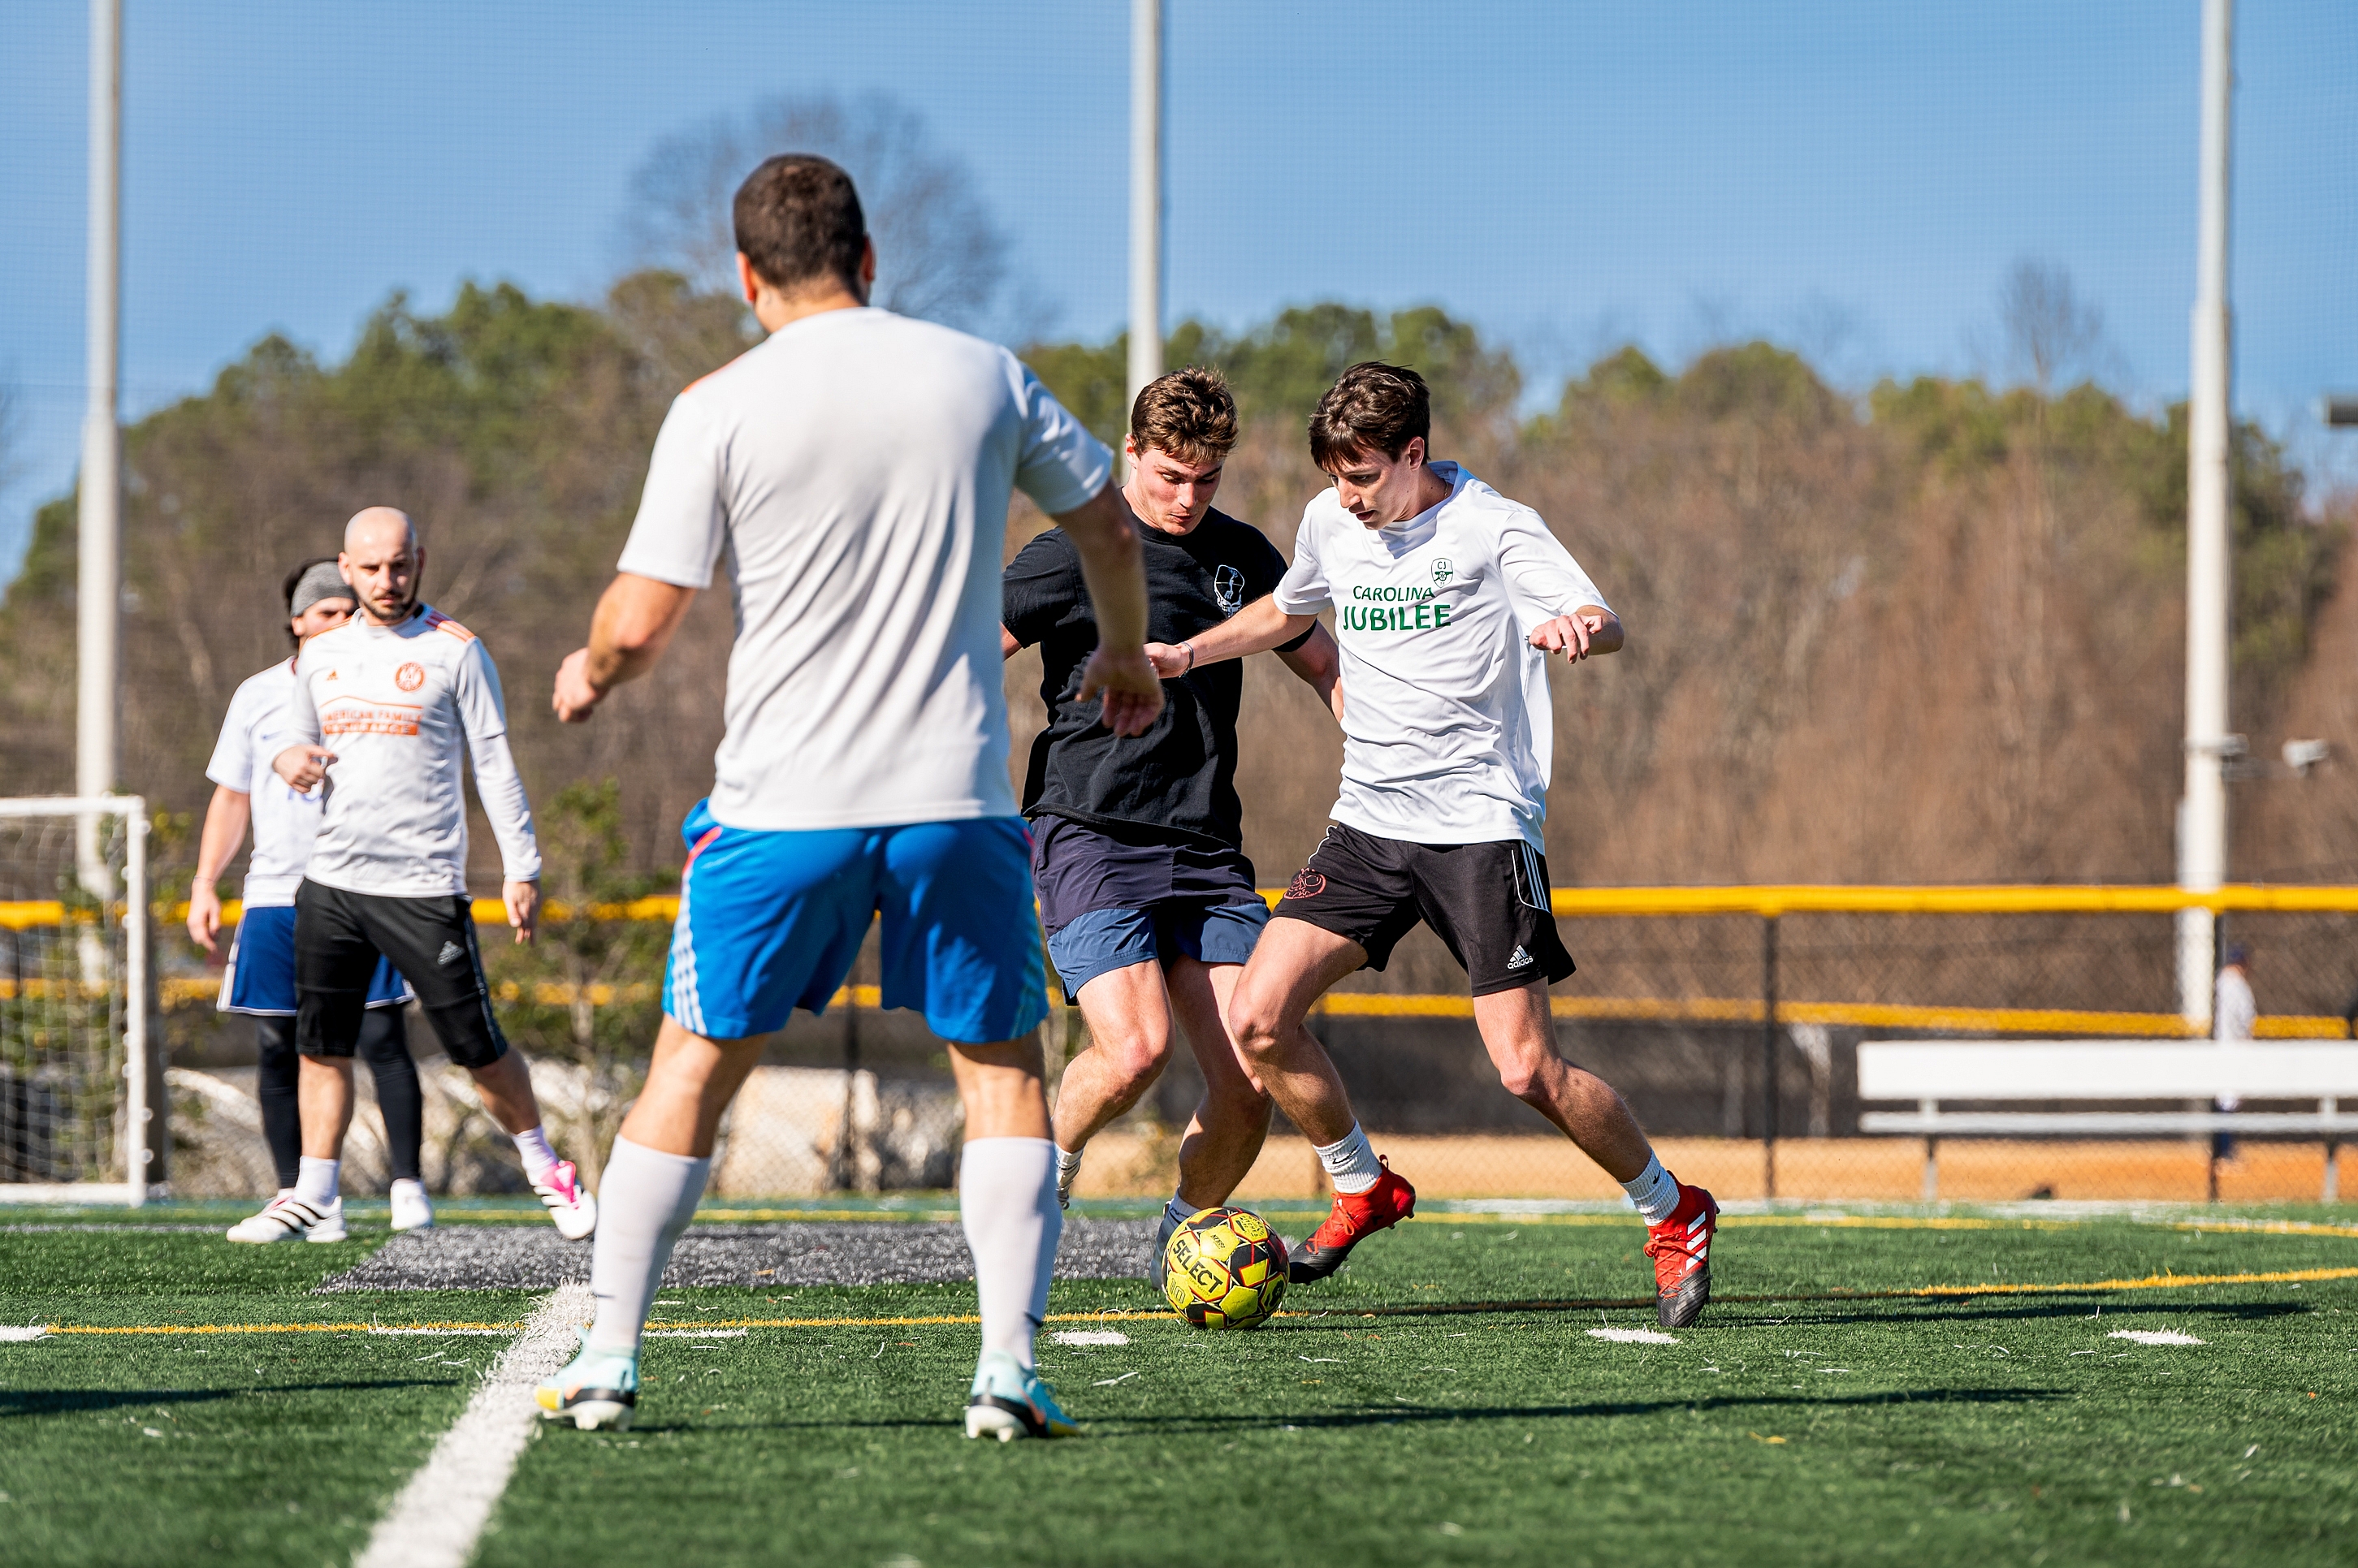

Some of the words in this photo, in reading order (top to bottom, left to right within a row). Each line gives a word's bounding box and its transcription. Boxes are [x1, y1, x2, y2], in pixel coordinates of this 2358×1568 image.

[1437, 561, 1447, 570] CJ
[1353, 585, 1436, 602] CAROLINA
[1343, 604, 1452, 631] JUBILEE
[1507, 955, 1534, 970] adidas
[1172, 1239, 1223, 1294] SELECT
[1170, 1277, 1186, 1304] 10
